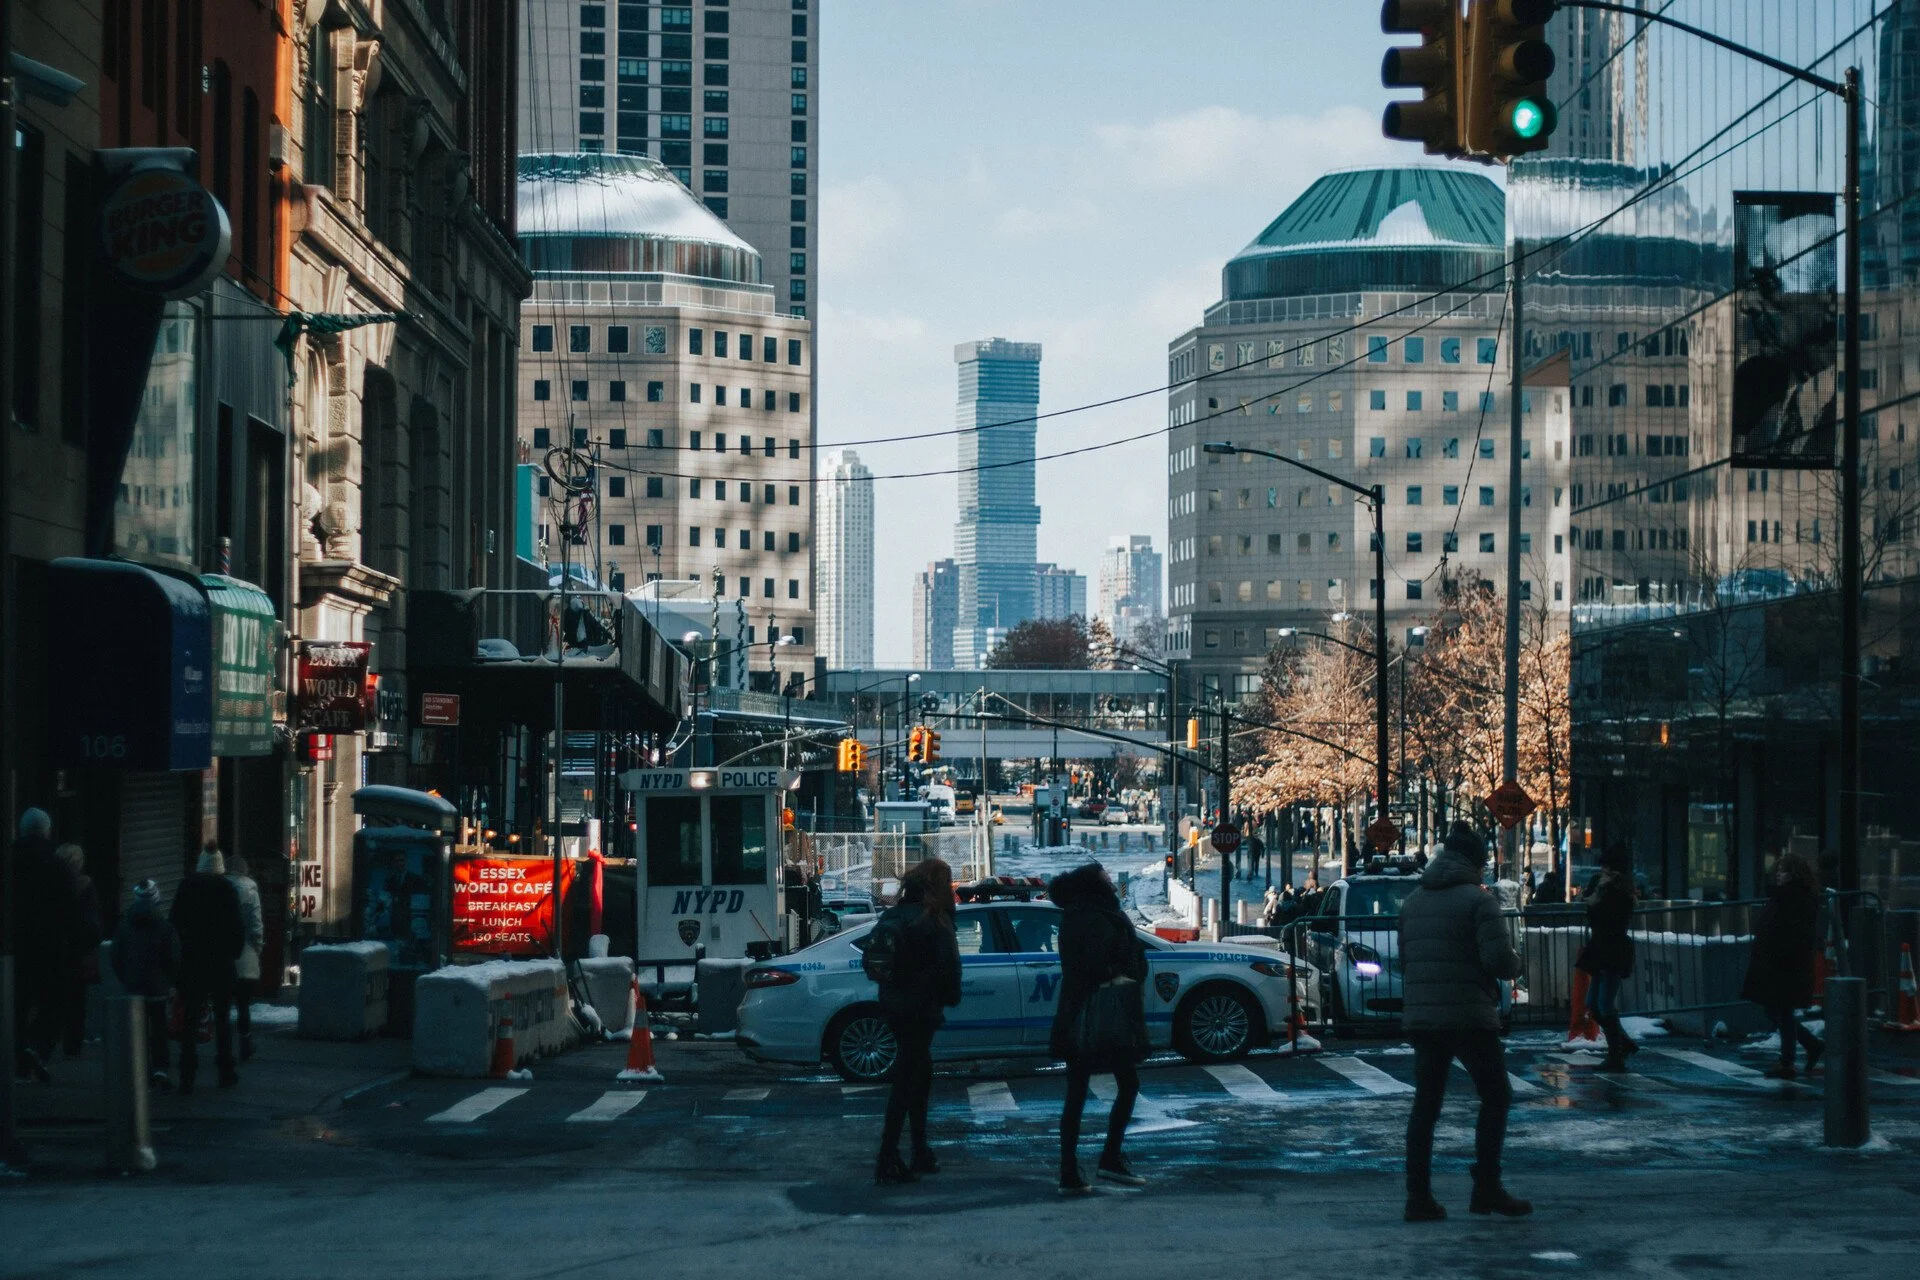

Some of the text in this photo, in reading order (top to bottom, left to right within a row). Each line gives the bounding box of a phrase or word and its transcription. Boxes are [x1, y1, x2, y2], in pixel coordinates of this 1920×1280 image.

[110, 191, 204, 231] BURGER
[111, 212, 208, 260] KING
[222, 613, 238, 665] HO
[304, 678, 358, 698] WORLD
[80, 735, 126, 758] 106
[641, 771, 777, 789] NYPD POLICE
[1213, 832, 1240, 844] STOP
[480, 868, 527, 879] ESSEX
[454, 881, 553, 894] WORLD CAFÉ
[468, 902, 538, 911] BREAKFAST
[672, 890, 744, 914] NYPD
[482, 918, 522, 927] LUNCH
[473, 933, 531, 942] 130 SEATS
[1209, 953, 1248, 961] POLICE
